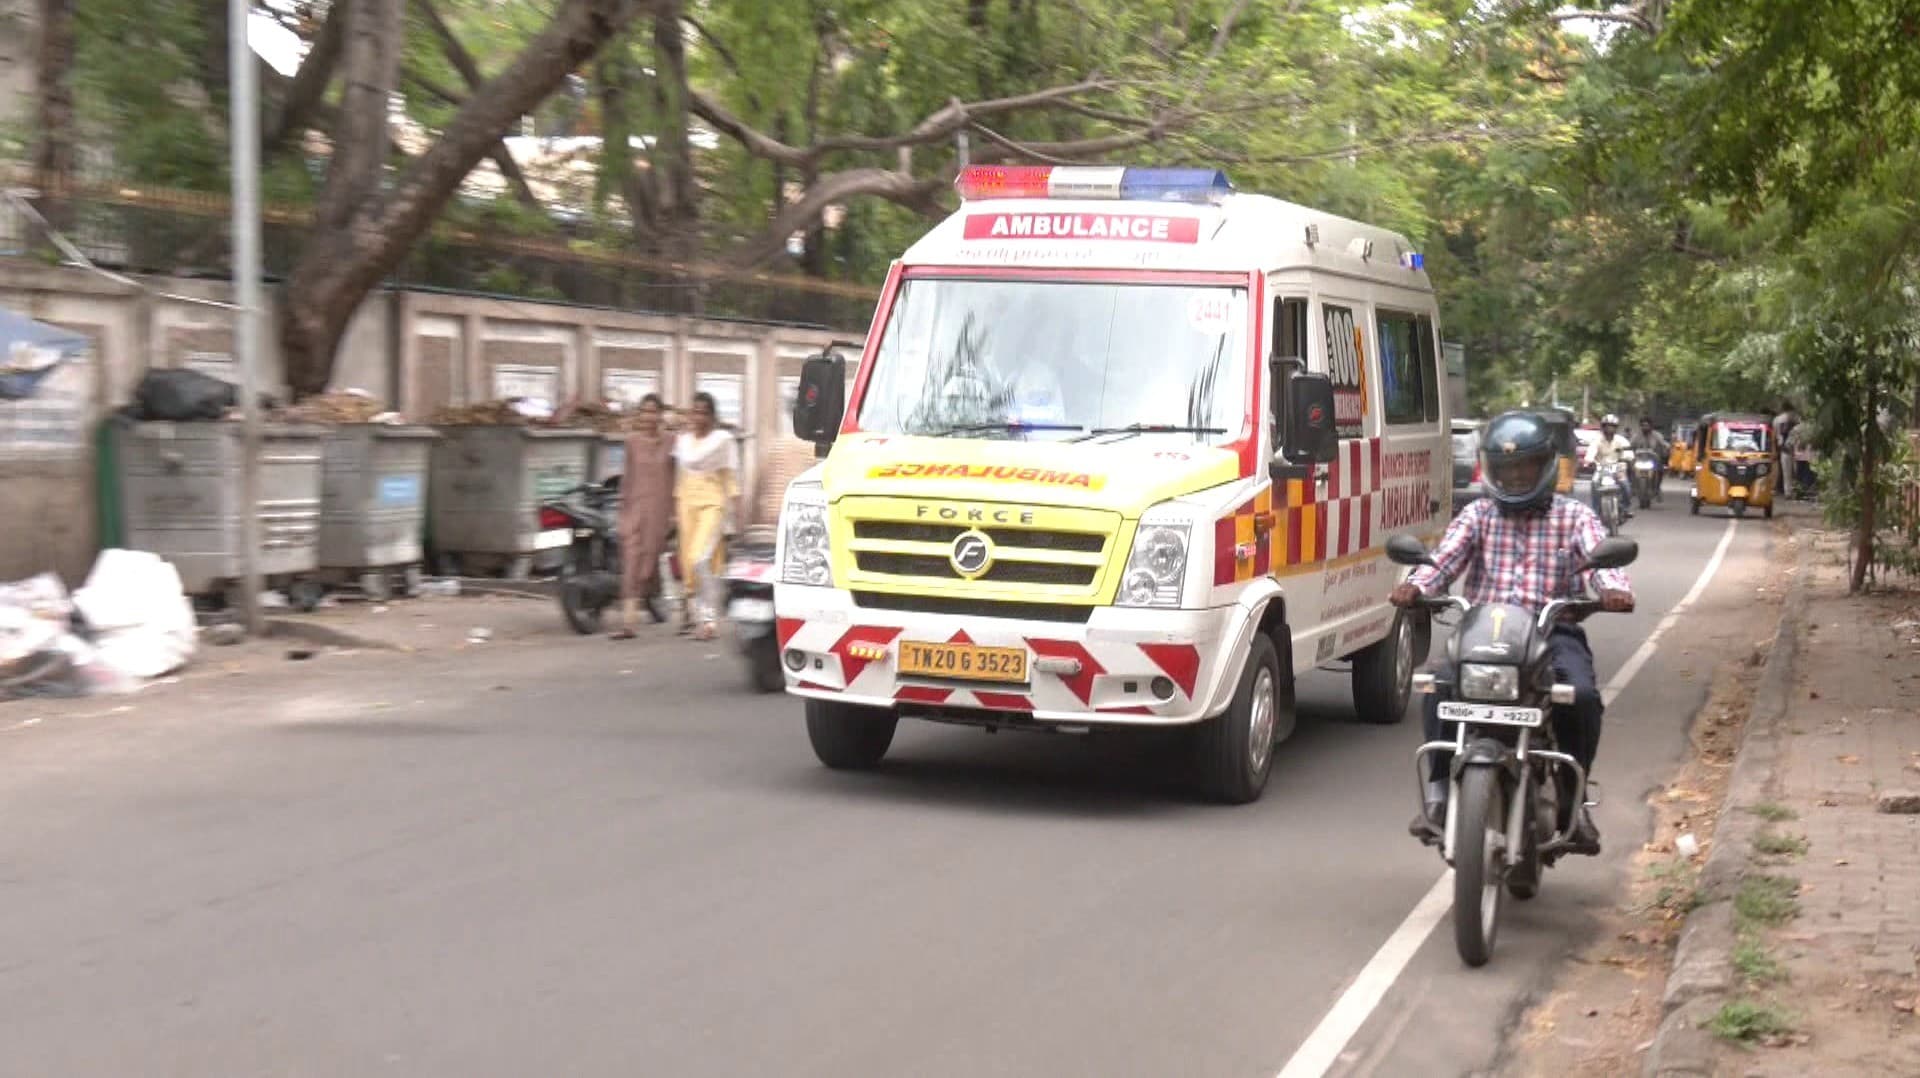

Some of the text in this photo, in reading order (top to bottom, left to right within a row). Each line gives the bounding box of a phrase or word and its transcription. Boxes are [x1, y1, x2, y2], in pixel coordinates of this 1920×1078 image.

[990, 215, 1169, 239] AMBULANCE
[916, 504, 1034, 525] FORCE
[1380, 480, 1430, 531] AMBULANCE
[911, 647, 1022, 674] TN20 G 3523
